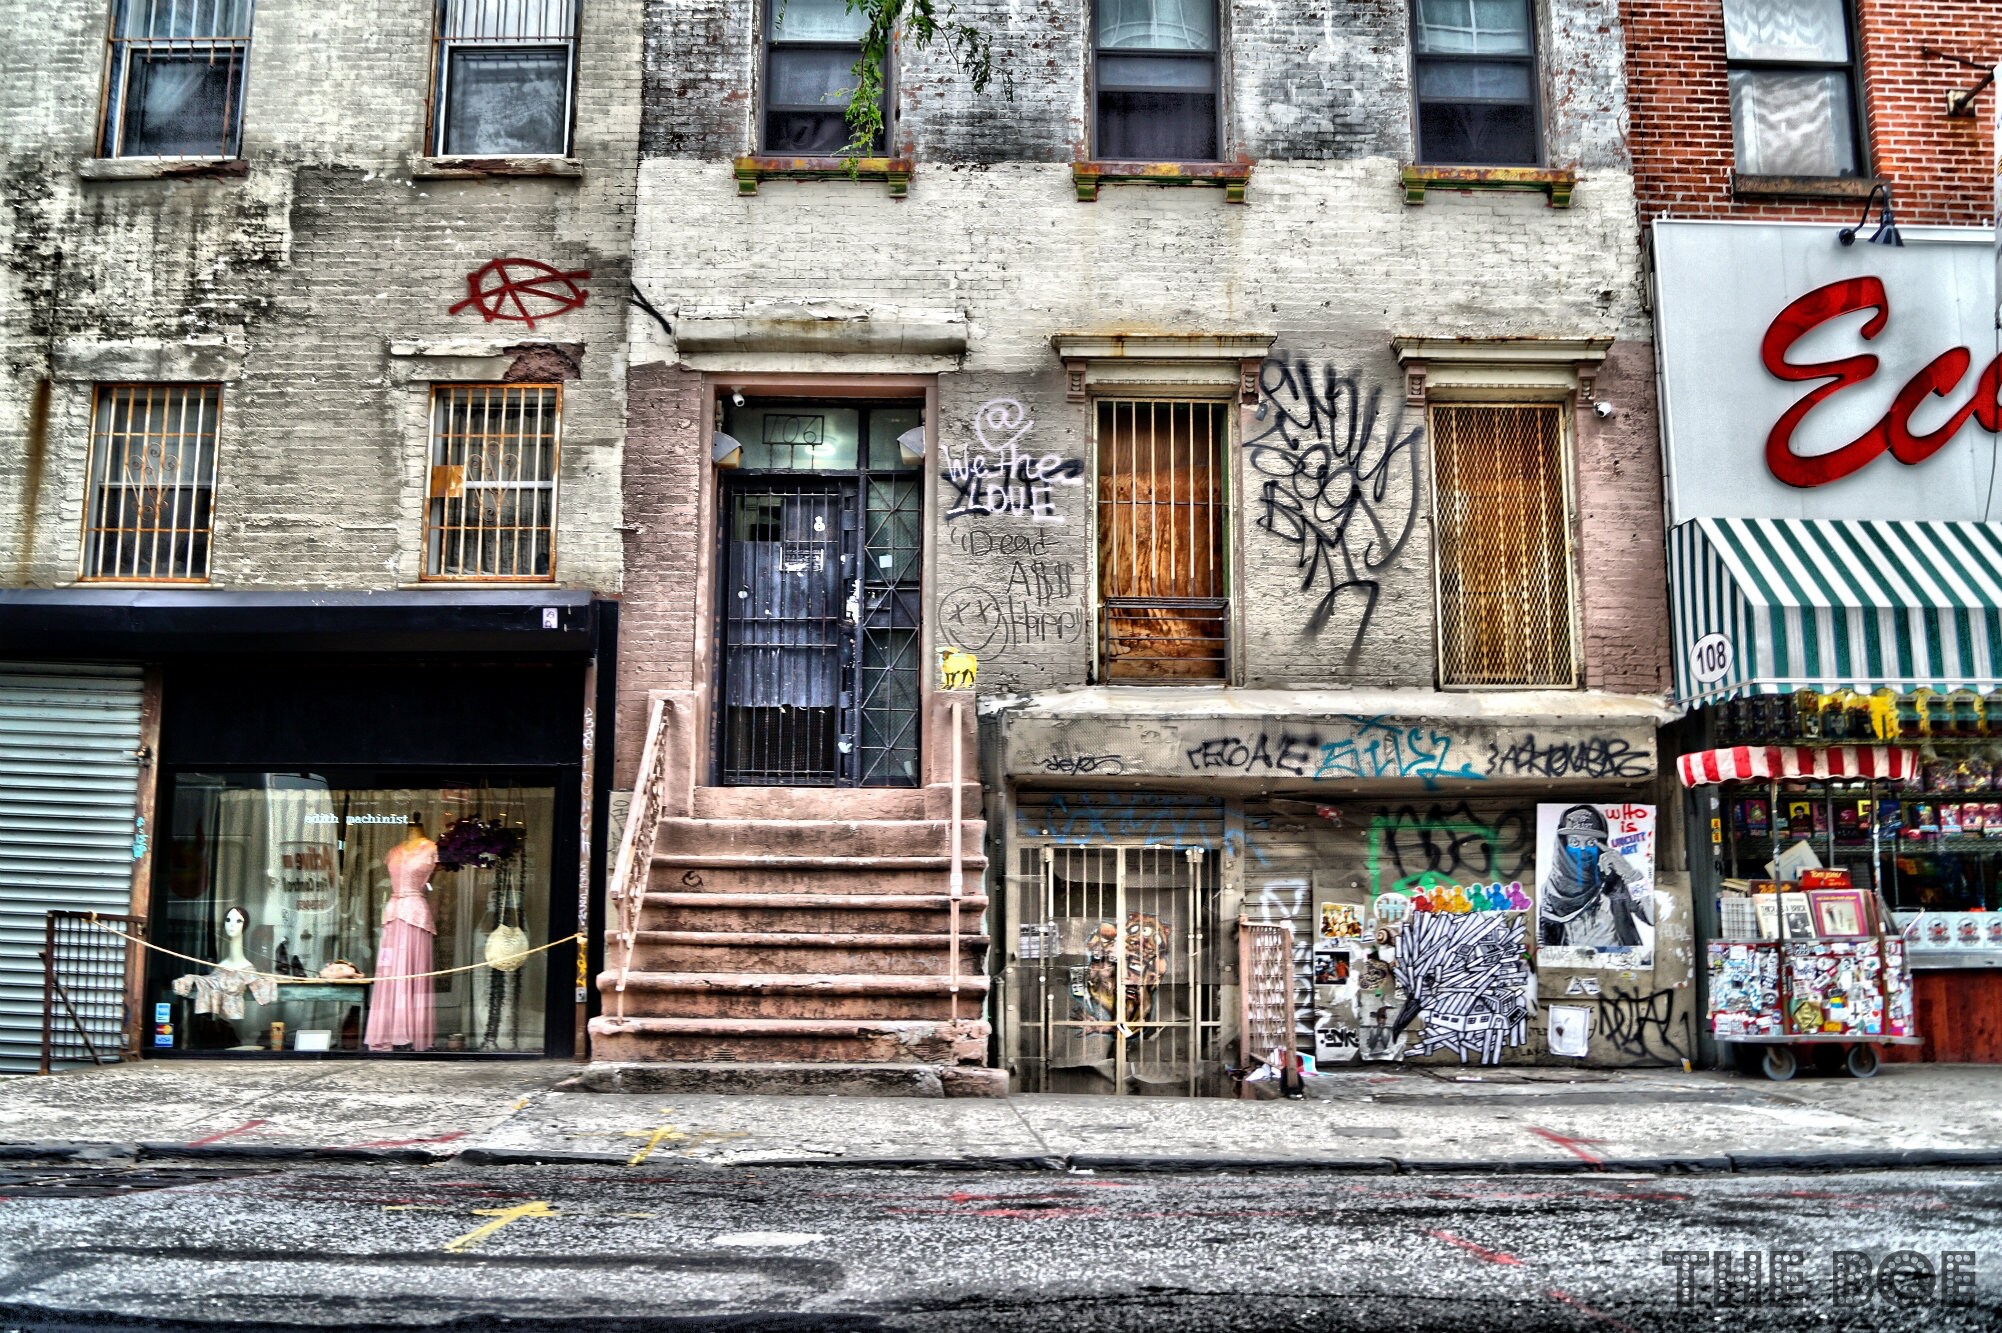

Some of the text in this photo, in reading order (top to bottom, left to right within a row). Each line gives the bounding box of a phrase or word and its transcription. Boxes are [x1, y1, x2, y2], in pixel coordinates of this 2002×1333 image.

[1696, 640, 1726, 675] 108
[304, 812, 409, 826] edith machinist
